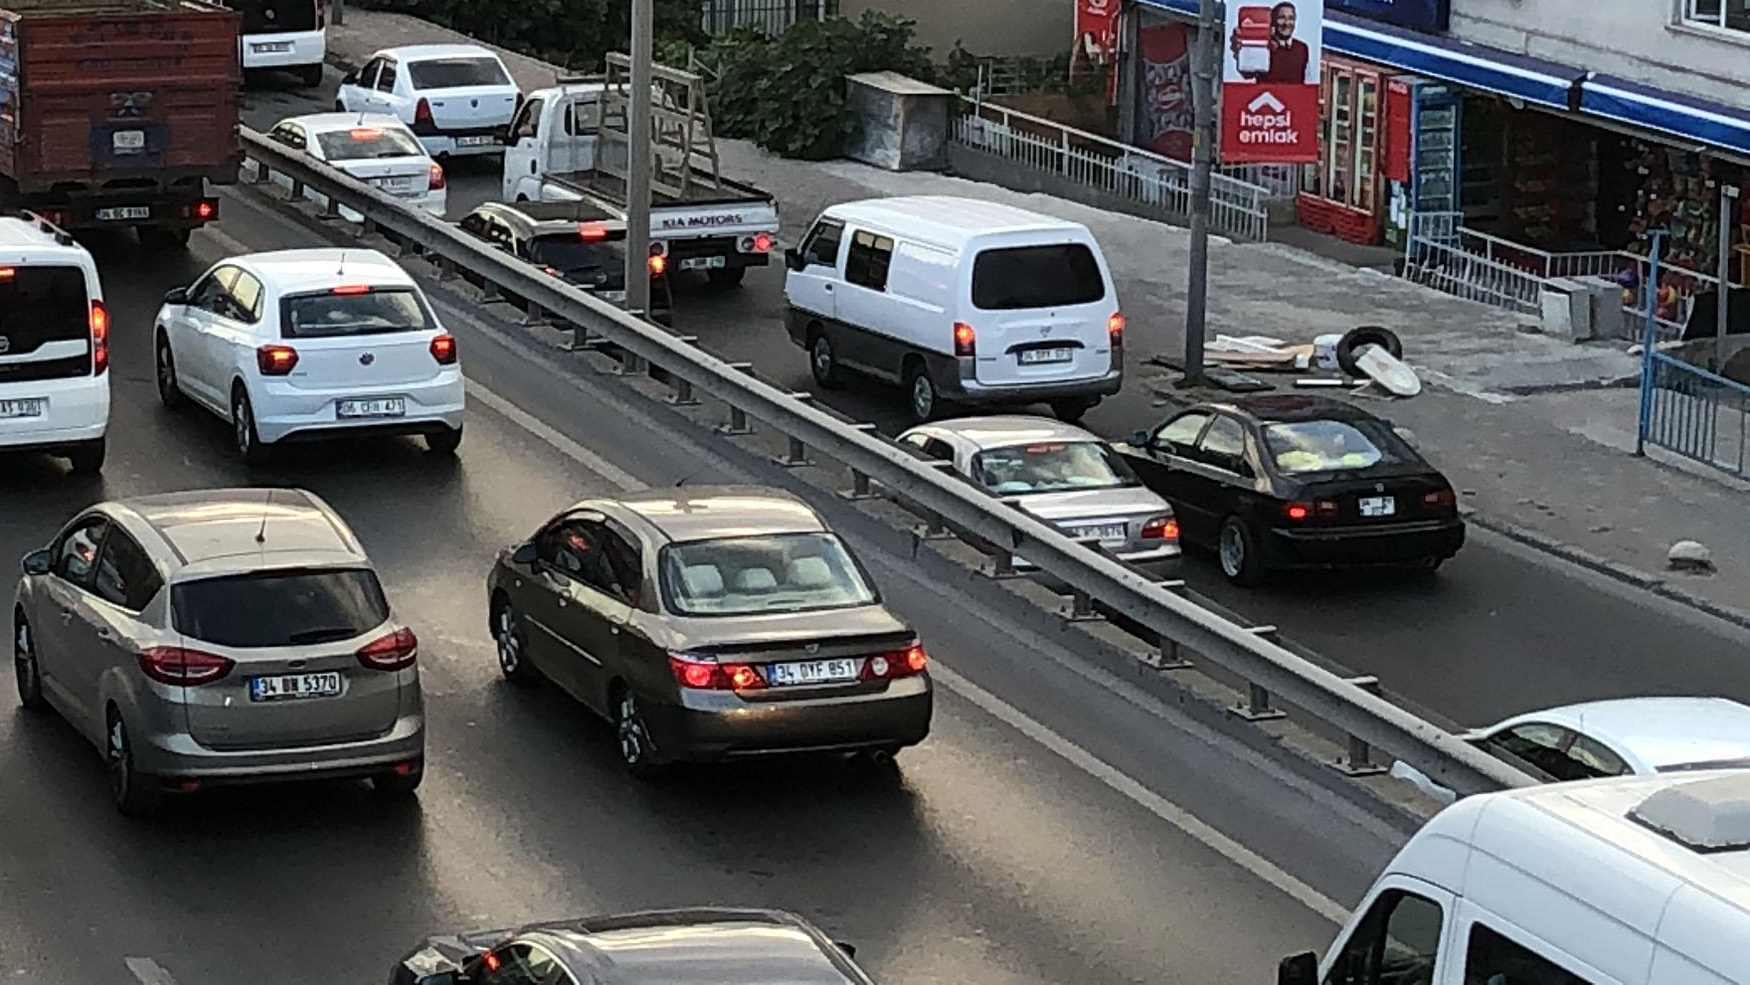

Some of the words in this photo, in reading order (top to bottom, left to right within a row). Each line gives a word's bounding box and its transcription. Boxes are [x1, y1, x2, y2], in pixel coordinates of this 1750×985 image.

[1240, 111, 1291, 130] hepsi
[1239, 129, 1299, 144] emlak
[662, 219, 686, 228] KIA
[687, 214, 743, 227] MOTORS
[778, 665, 794, 679] 34
[260, 678, 276, 694] 34
[304, 674, 337, 692] 5370
